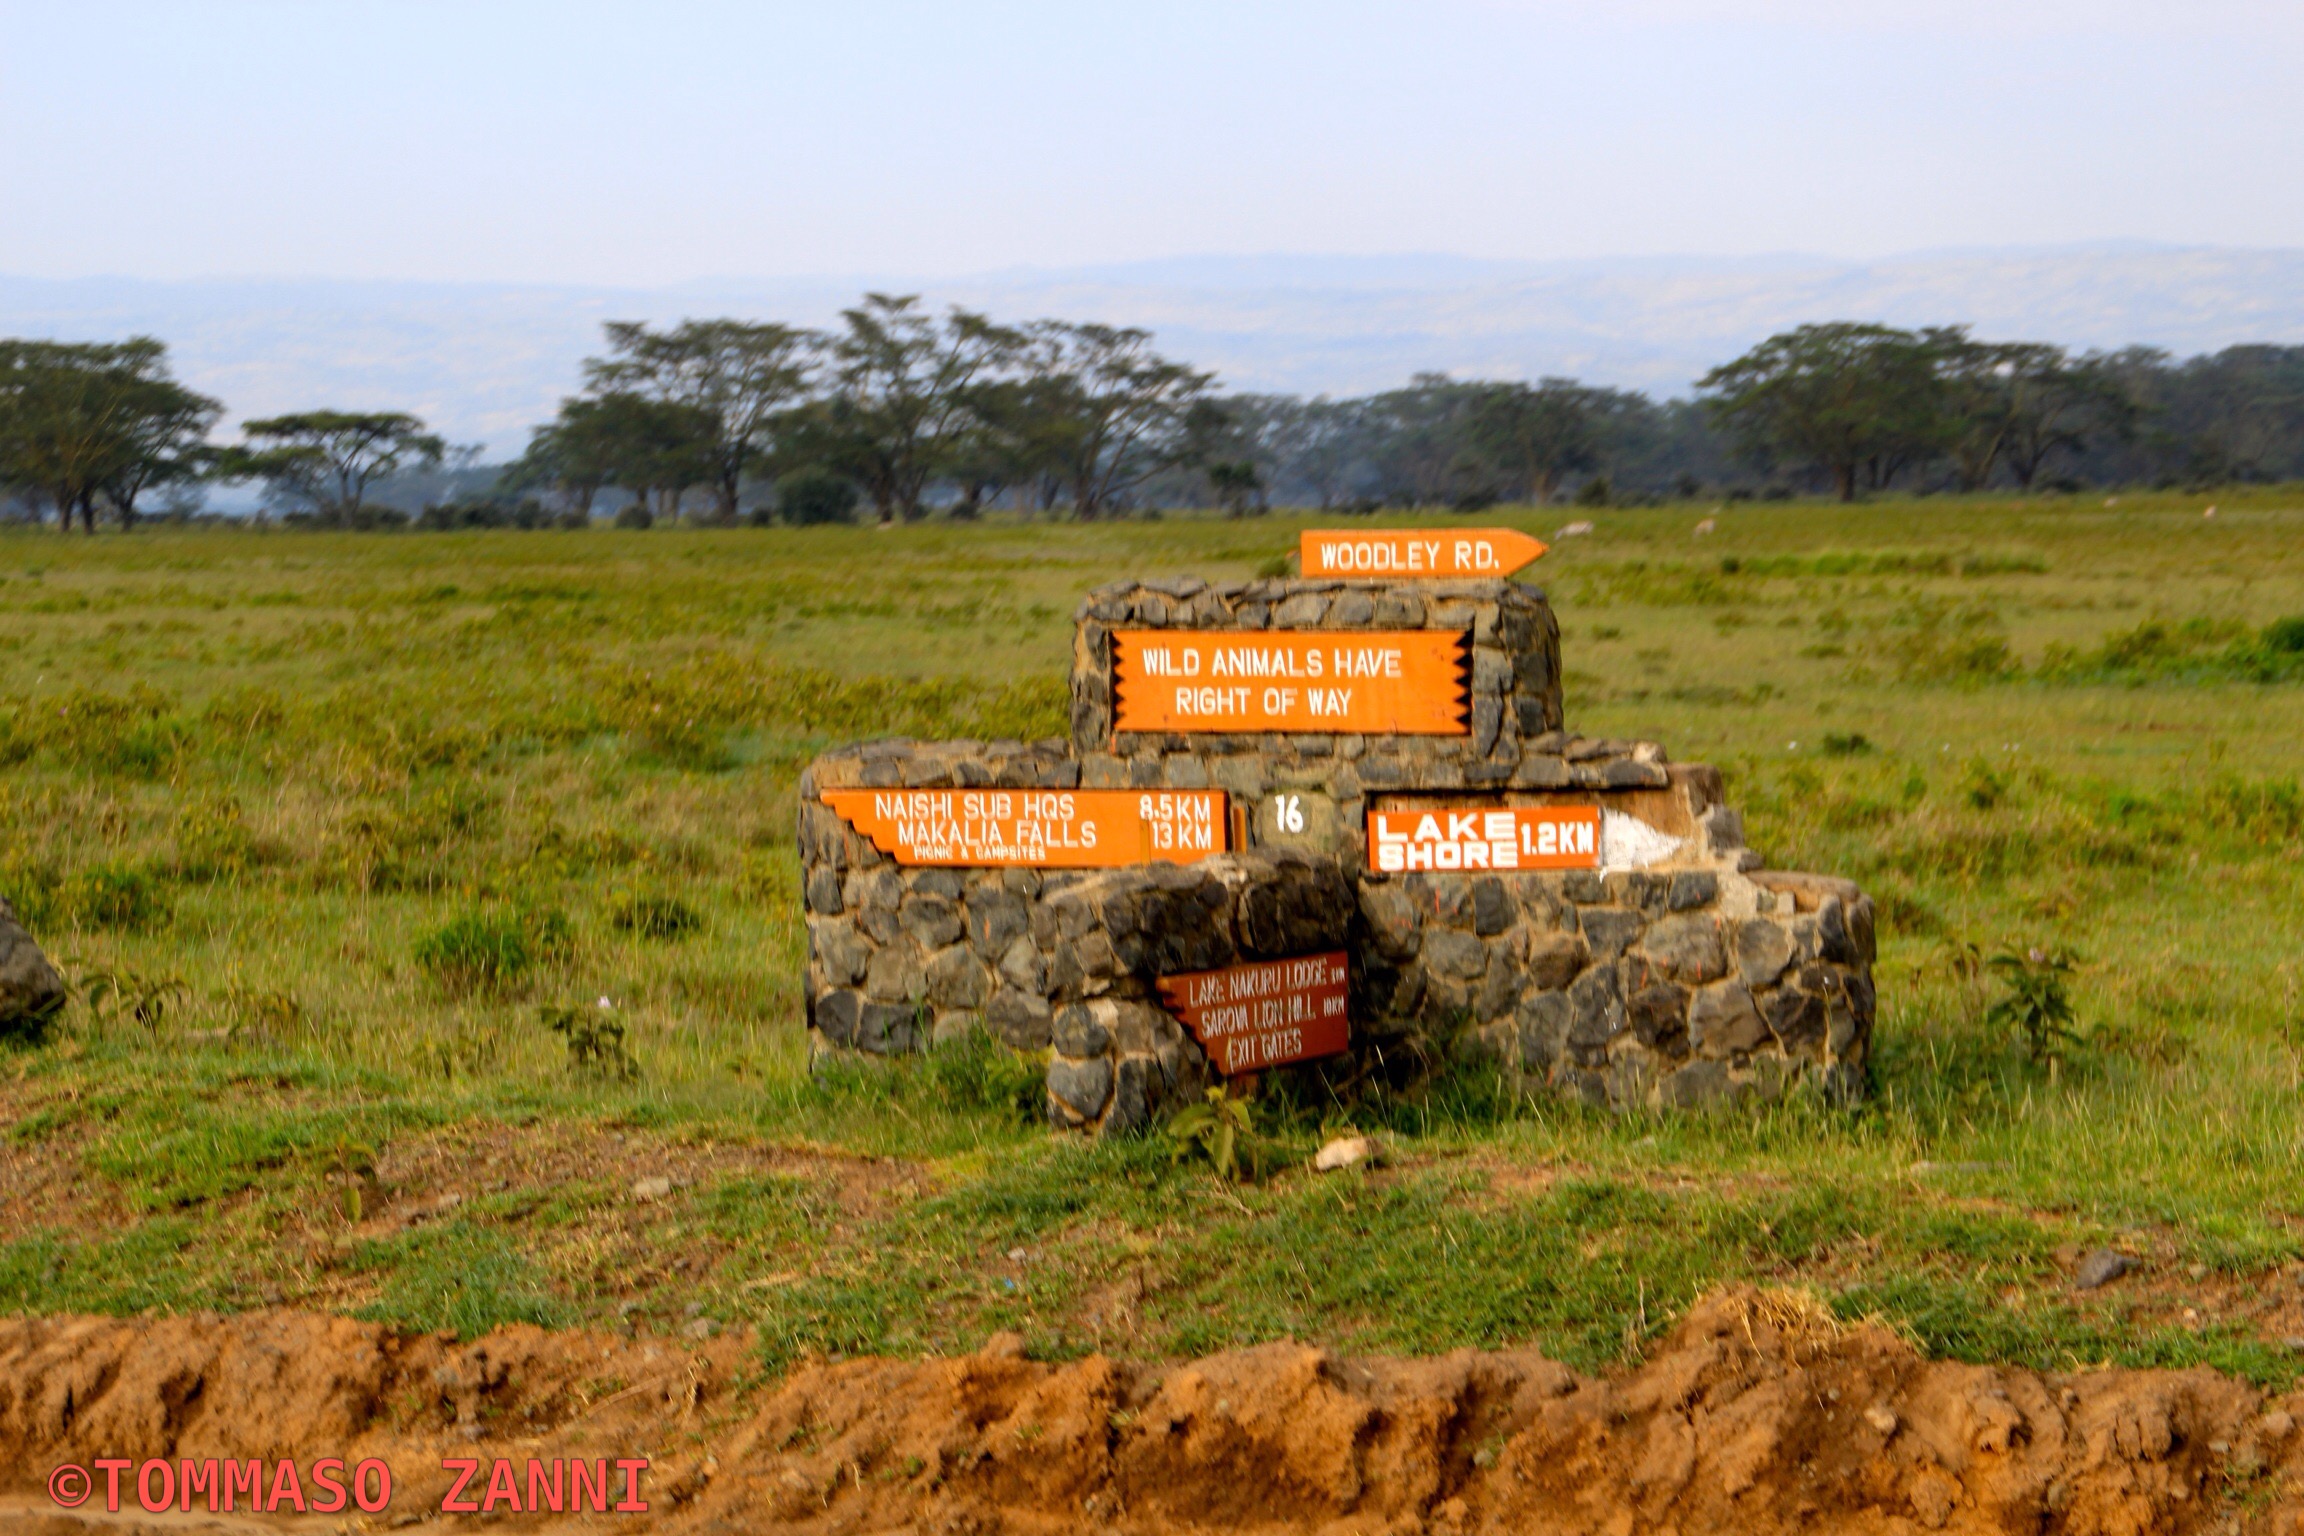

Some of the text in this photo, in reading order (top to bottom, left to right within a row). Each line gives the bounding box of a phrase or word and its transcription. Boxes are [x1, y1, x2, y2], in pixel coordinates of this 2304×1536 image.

[1320, 540, 1500, 570] WOODLEY RD.
[1142, 648, 1402, 678] WILD ANIMALS HAVE
[1175, 686, 1352, 716] RIGHT OF WAY
[874, 794, 952, 821] NAISHI
[963, 793, 1012, 821] SUB
[1024, 793, 1075, 820] HQS
[1275, 794, 1304, 833] 16
[897, 820, 1002, 848] MAKALIA
[1016, 820, 1097, 848] FALLS
[1377, 811, 1516, 843] LAKE
[1378, 841, 1517, 871] SHORE
[1189, 974, 1226, 1008] LAKE
[1229, 966, 1281, 1001] NAKURU
[1286, 957, 1328, 990] LODGE
[1202, 1004, 1249, 1039] SAROVA
[1253, 998, 1284, 1030] LION
[1288, 993, 1316, 1025] HILL
[1229, 1027, 1302, 1073] EXIT GATES
